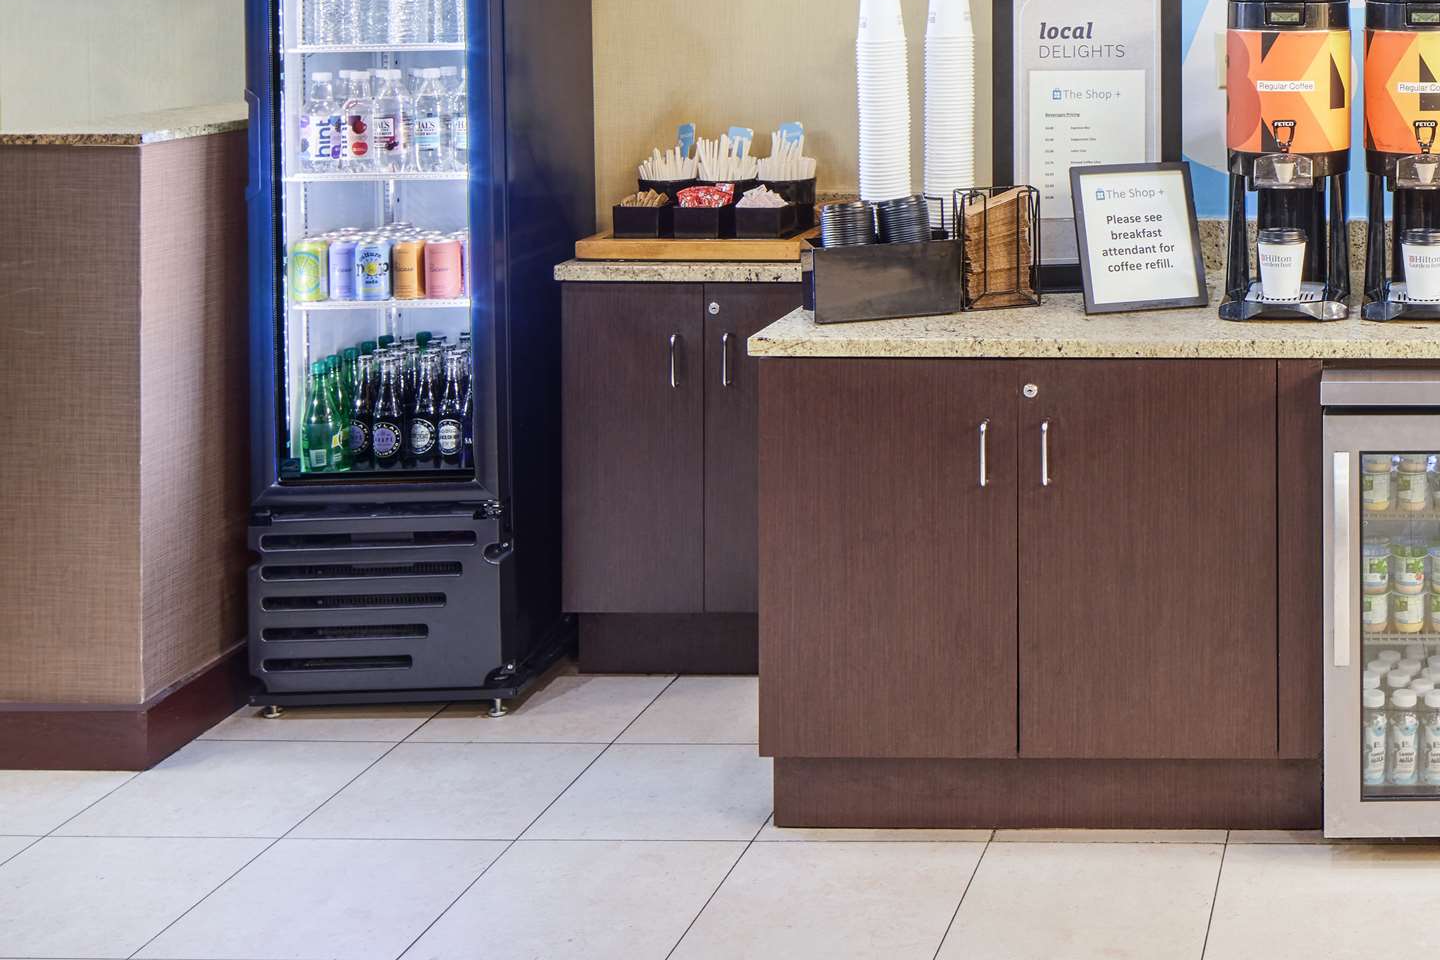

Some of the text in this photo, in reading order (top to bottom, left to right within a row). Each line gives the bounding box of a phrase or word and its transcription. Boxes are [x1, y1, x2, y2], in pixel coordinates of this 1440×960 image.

[1039, 22, 1094, 40] local
[1039, 44, 1126, 59] DELIGHTS
[1259, 82, 1314, 91] Regular Coffee
[1400, 84, 1428, 93] Regular
[1063, 90, 1082, 100] The
[1086, 89, 1112, 102] Shop
[315, 118, 331, 158] hint
[1106, 188, 1126, 200] The
[1128, 188, 1154, 202] Shop
[1106, 214, 1163, 225] Please see
[1111, 227, 1162, 240] breakfast
[1102, 242, 1175, 257] attendant for
[1264, 254, 1292, 262] Hilton
[1108, 258, 1174, 273] coffee refill.
